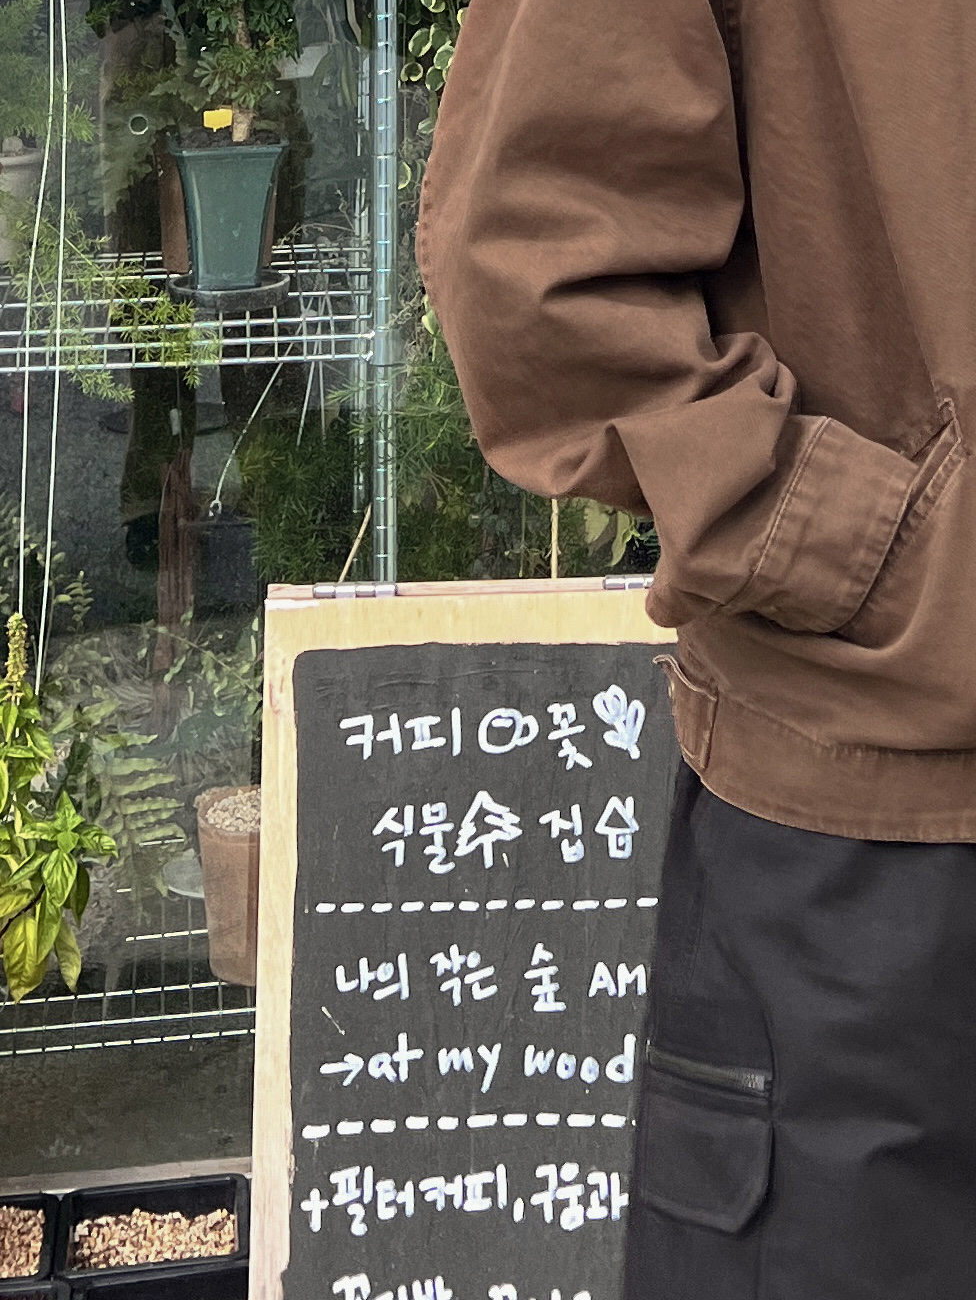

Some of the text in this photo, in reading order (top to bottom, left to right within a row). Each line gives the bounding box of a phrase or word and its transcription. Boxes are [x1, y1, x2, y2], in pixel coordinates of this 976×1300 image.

[339, 702, 594, 771] 커피 꽃
[372, 801, 586, 875] 식물 집
[335, 952, 410, 1001] 나의
[429, 943, 499, 1006] 작은
[524, 942, 567, 1013] 숲
[367, 1032, 637, 1094] at my wood
